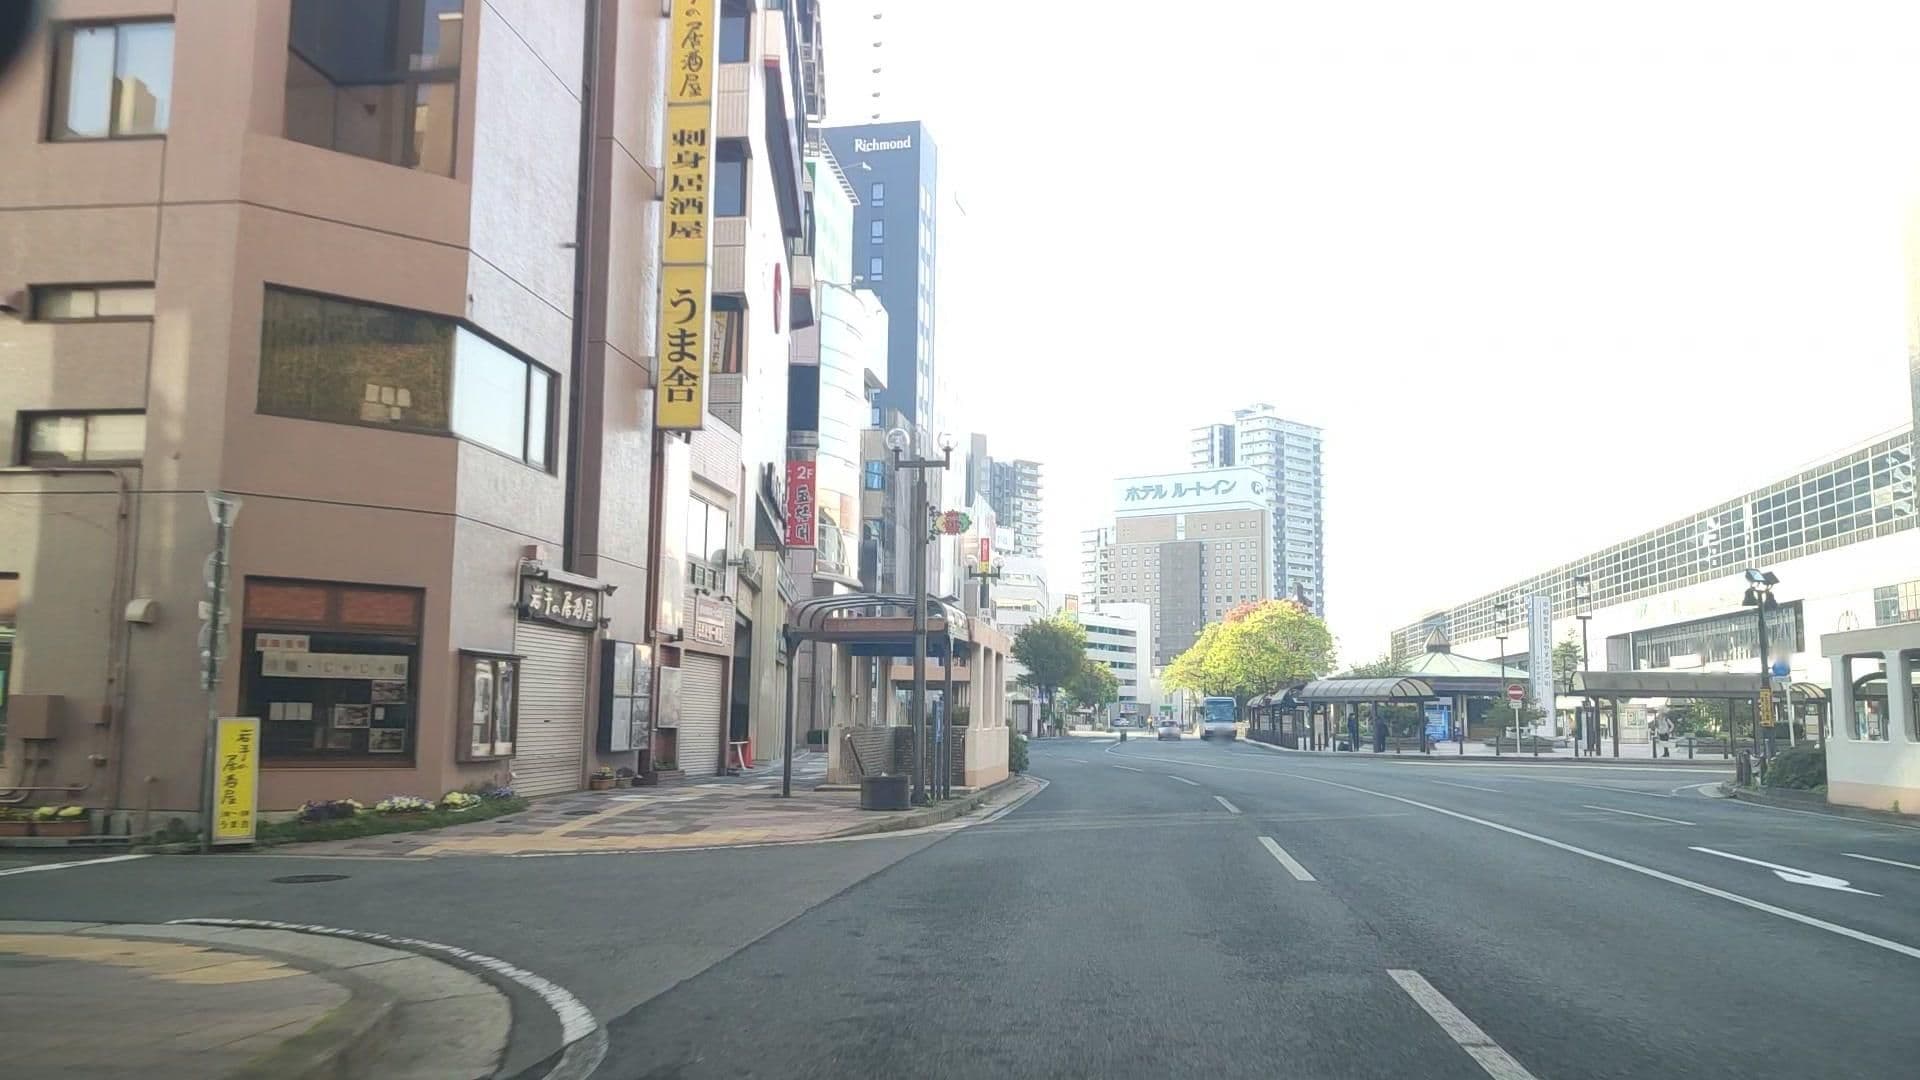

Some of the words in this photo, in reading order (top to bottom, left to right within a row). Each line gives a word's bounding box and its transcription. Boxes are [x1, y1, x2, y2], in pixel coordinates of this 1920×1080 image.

[854, 135, 912, 153] Richmond
[669, 128, 706, 239] 刺身居酒屋
[662, 287, 699, 403] うま舎
[797, 466, 814, 480] 2F
[1125, 484, 1168, 501] ホテル
[1171, 479, 1237, 498] ルートイン
